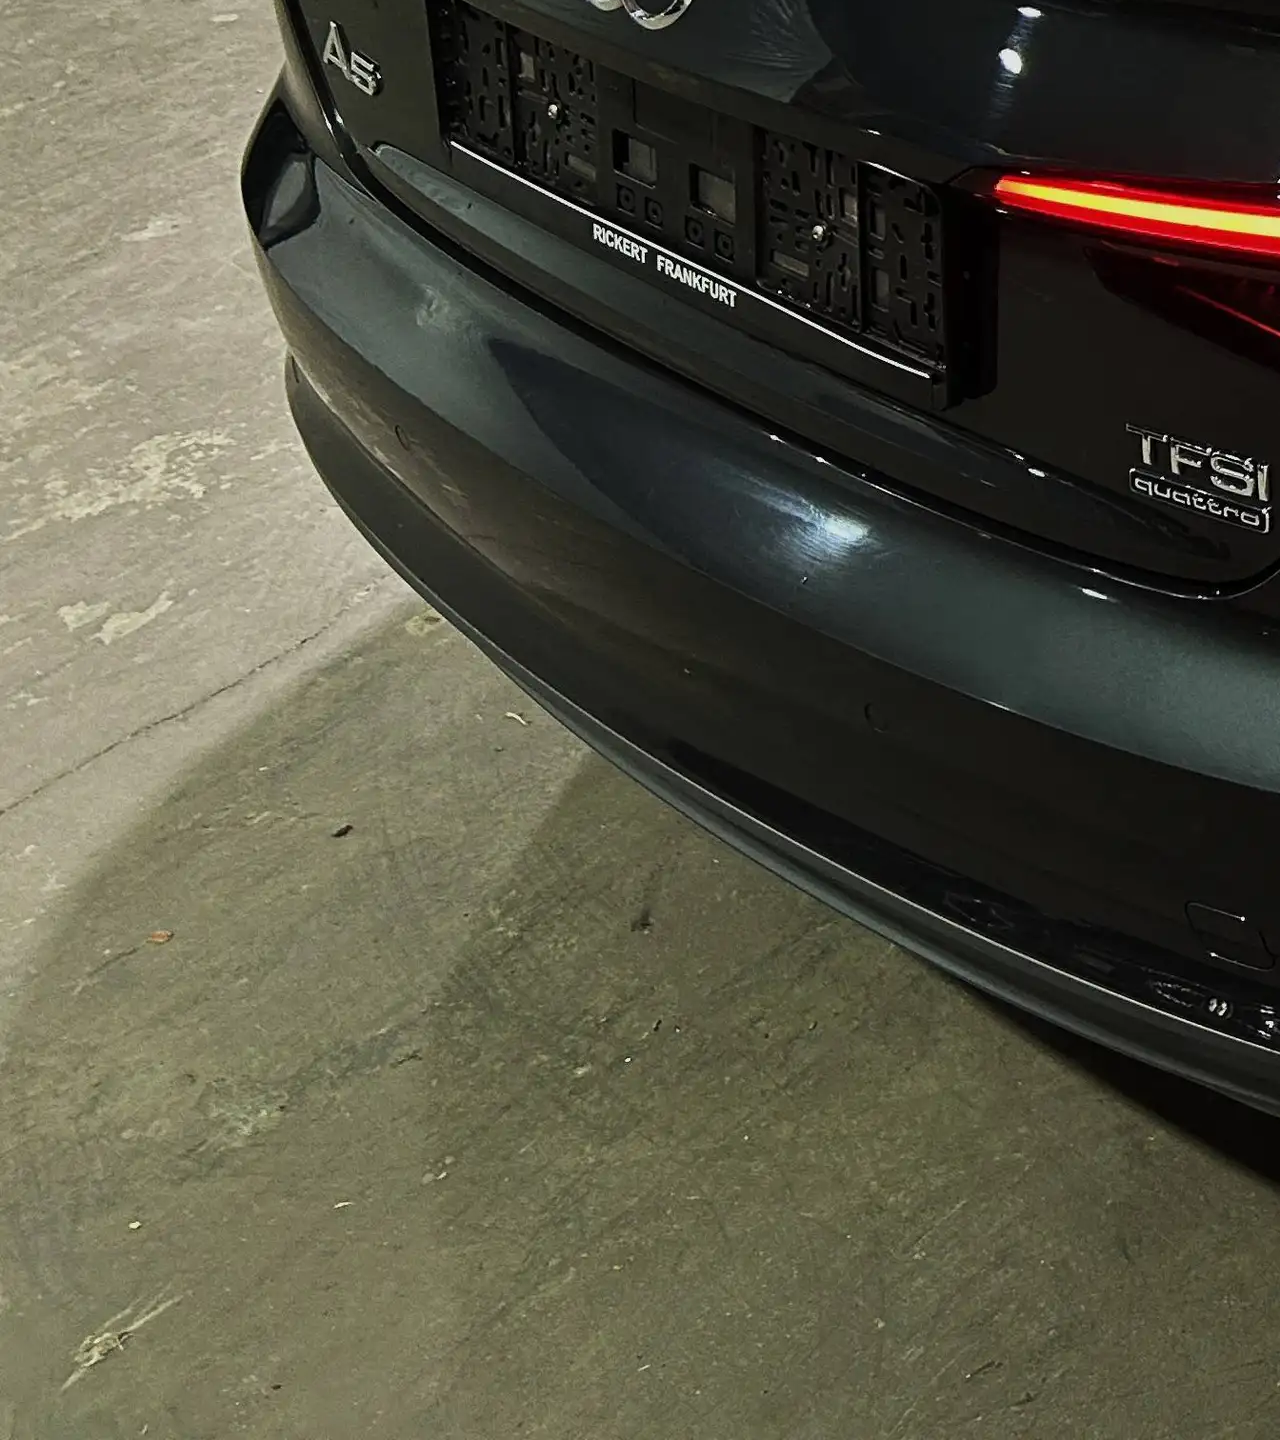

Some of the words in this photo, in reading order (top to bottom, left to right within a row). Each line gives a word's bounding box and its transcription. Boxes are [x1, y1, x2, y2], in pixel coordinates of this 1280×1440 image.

[322, 20, 382, 96] A5
[592, 222, 649, 264] RICKERT
[656, 253, 738, 308] FRANKFURT
[1125, 422, 1270, 502] TFSI
[1133, 476, 1261, 527] quattro
